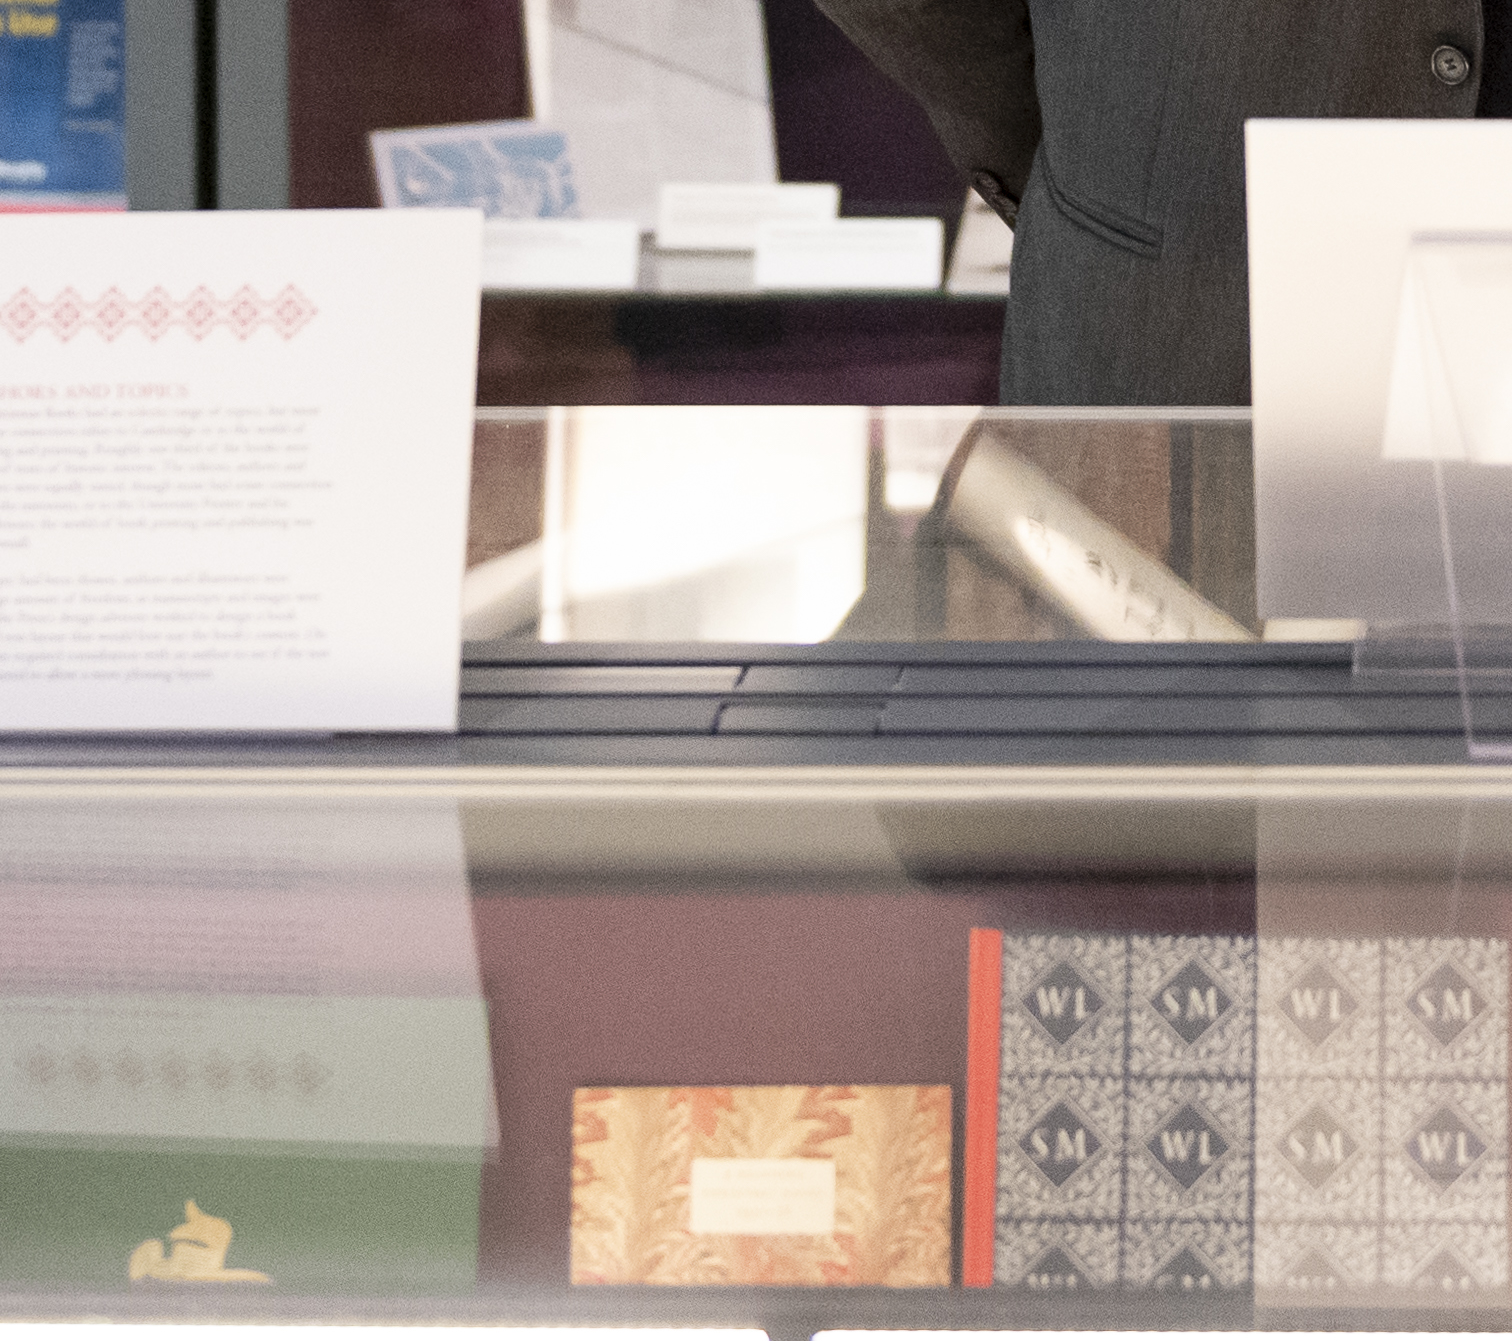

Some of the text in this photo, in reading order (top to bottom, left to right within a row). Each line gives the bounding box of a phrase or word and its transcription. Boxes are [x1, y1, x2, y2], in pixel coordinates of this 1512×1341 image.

[65, 383, 111, 400] AND
[115, 382, 189, 399] TOPICS
[1035, 984, 1475, 1021] WL SM WL SM
[1029, 1128, 1472, 1164] SM WL SM WL
